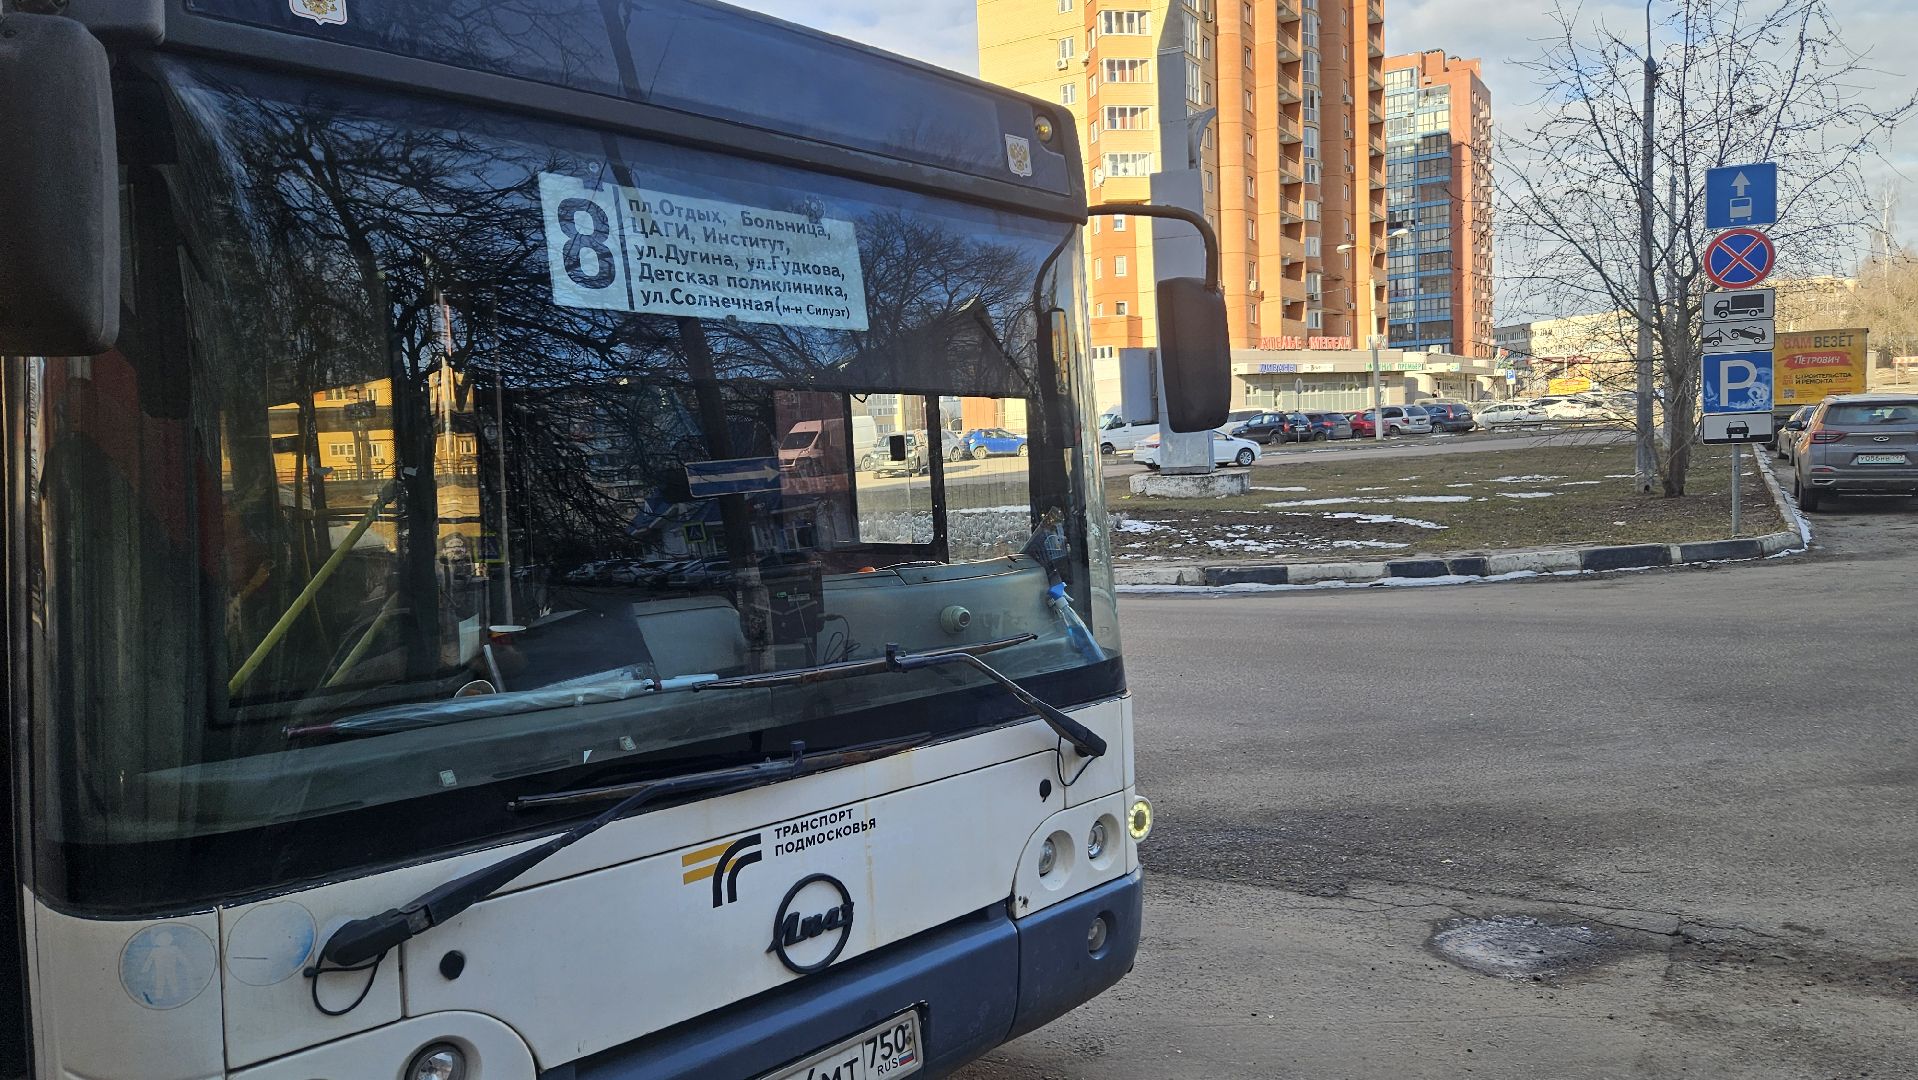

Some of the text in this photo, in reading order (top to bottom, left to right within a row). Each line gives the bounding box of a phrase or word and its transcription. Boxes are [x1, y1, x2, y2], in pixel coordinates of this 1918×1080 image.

[628, 199, 831, 240] пл.Отдых, Больница,
[630, 216, 791, 255] ЦАГИ, Институт,
[557, 198, 617, 289] 8
[634, 244, 845, 281] ул.Дугина, ул.Гудкова,
[638, 262, 848, 301] Детская поликлиника,
[1783, 332, 1854, 349] ВАМ ВЕЗЁТ
[774, 808, 854, 839] ТРАНСПОРТ
[775, 818, 876, 856] ПОДМОСКОВЬЯ
[865, 1024, 906, 1068] 750
[877, 1059, 899, 1077] RUS
